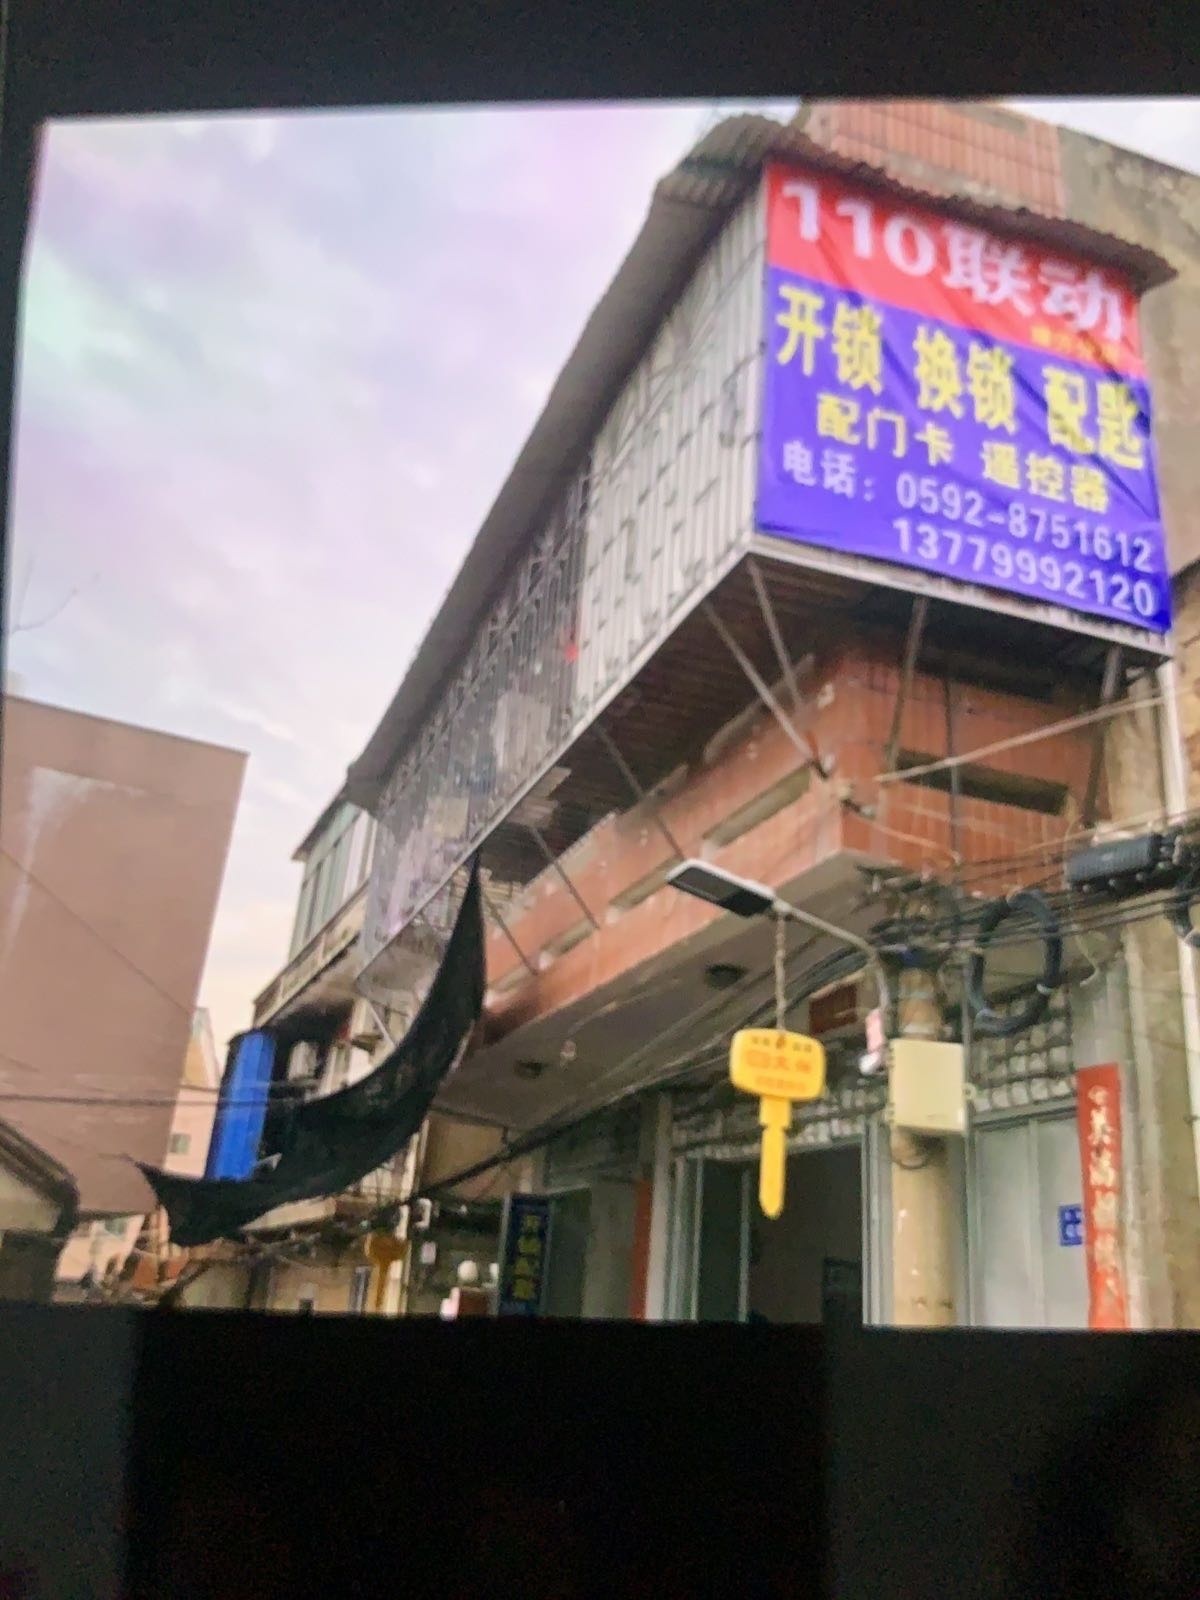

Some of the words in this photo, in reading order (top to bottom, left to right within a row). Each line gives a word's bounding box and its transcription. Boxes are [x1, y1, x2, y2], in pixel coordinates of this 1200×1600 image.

[782, 180, 1124, 343] 110联动
[775, 284, 885, 395] 开锁
[912, 324, 1017, 435] 换锁
[1041, 364, 1145, 471] 配匙
[816, 391, 955, 467] 配门卡
[979, 440, 1110, 515] 遥控器
[891, 517, 1156, 618] 13779992120
[896, 471, 1153, 574] 0592-8751612
